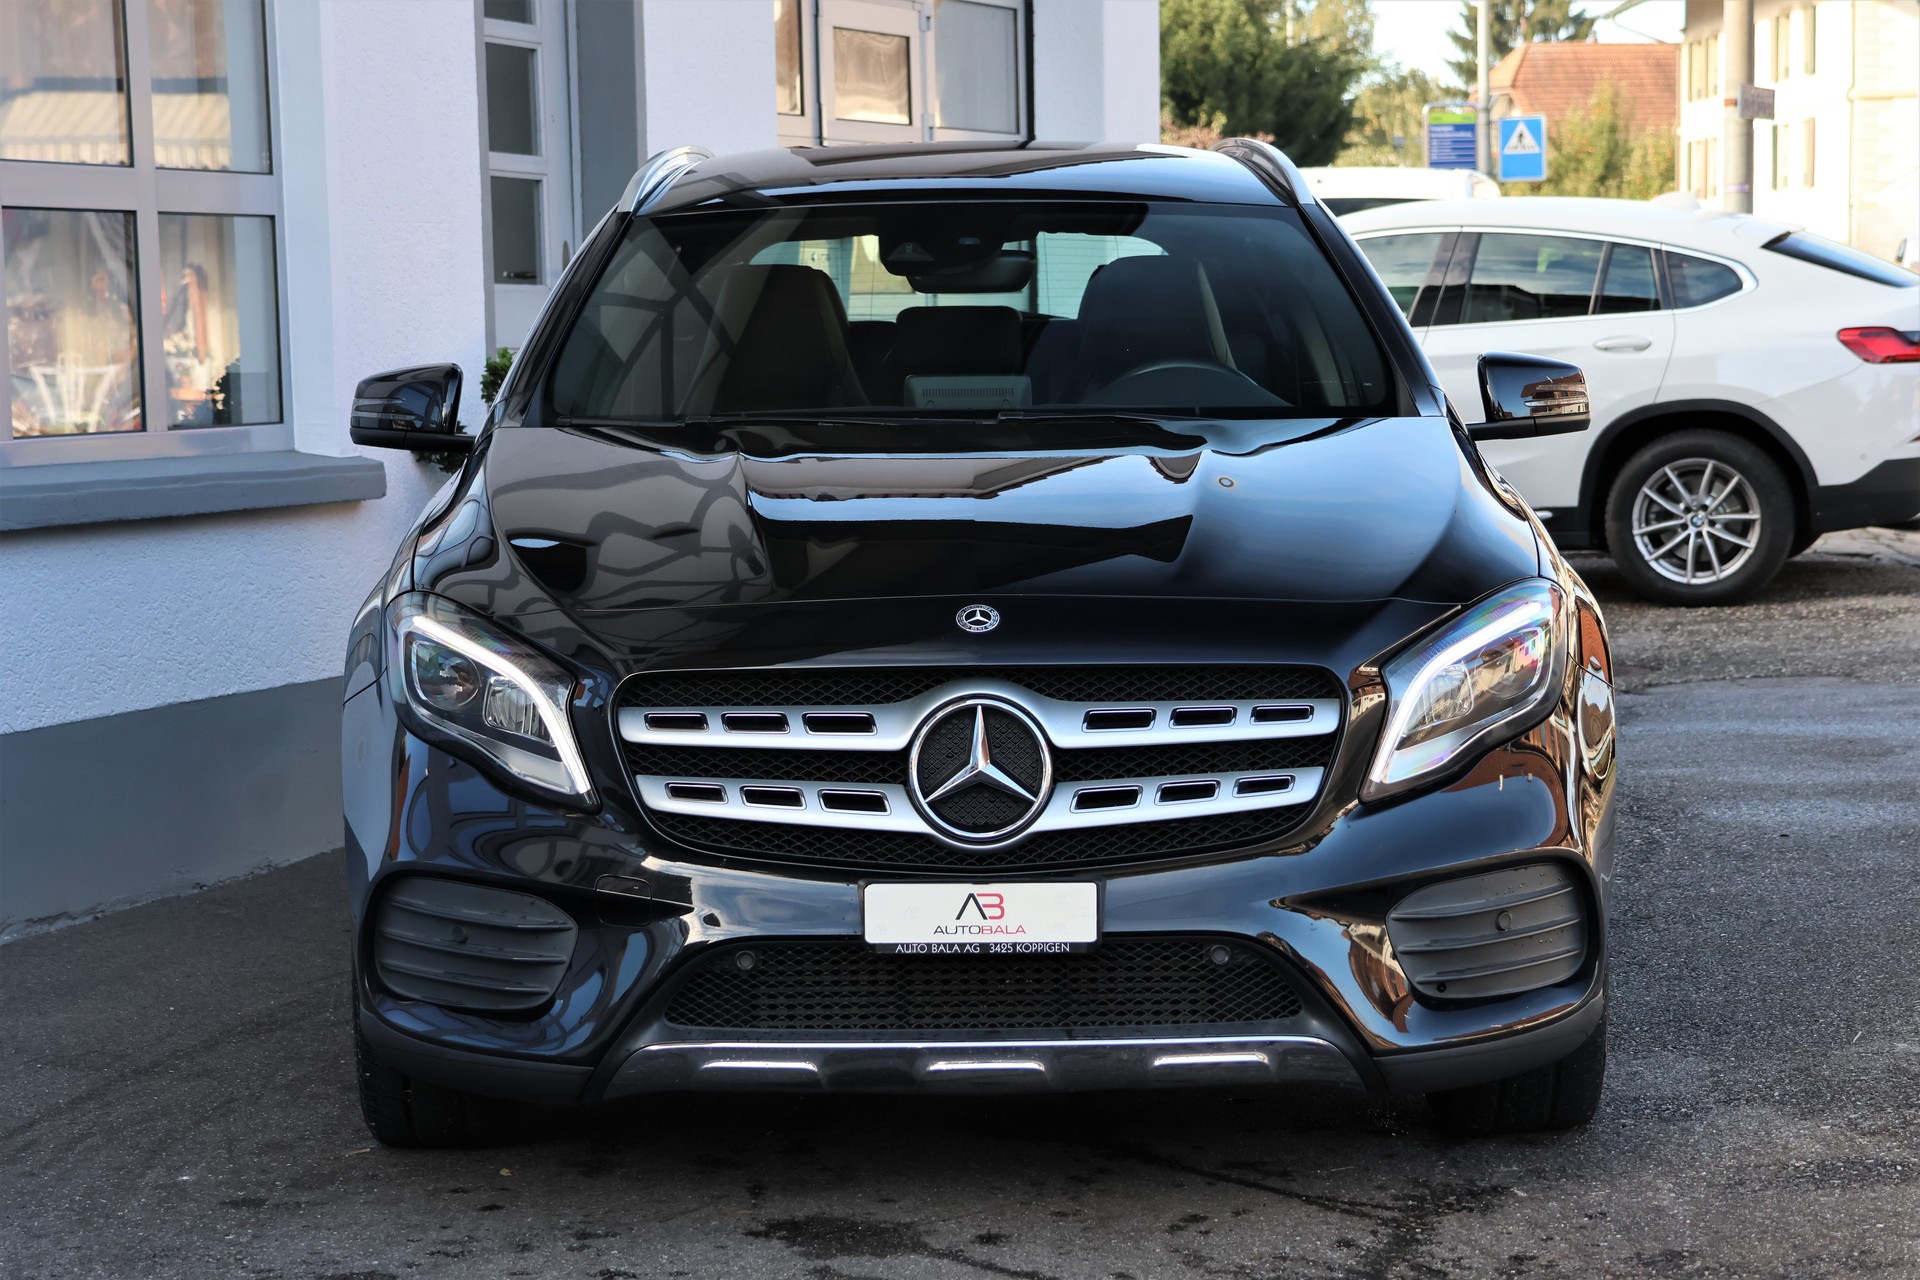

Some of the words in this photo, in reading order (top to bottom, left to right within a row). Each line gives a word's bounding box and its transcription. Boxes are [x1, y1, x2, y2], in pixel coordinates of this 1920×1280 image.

[933, 925, 1027, 935] AUTOBALA
[895, 943, 928, 953] AUTO
[931, 943, 960, 953] BALA
[963, 943, 980, 953] AG
[989, 943, 1013, 953] 3425
[1016, 942, 1070, 953] KOPPIGEN
